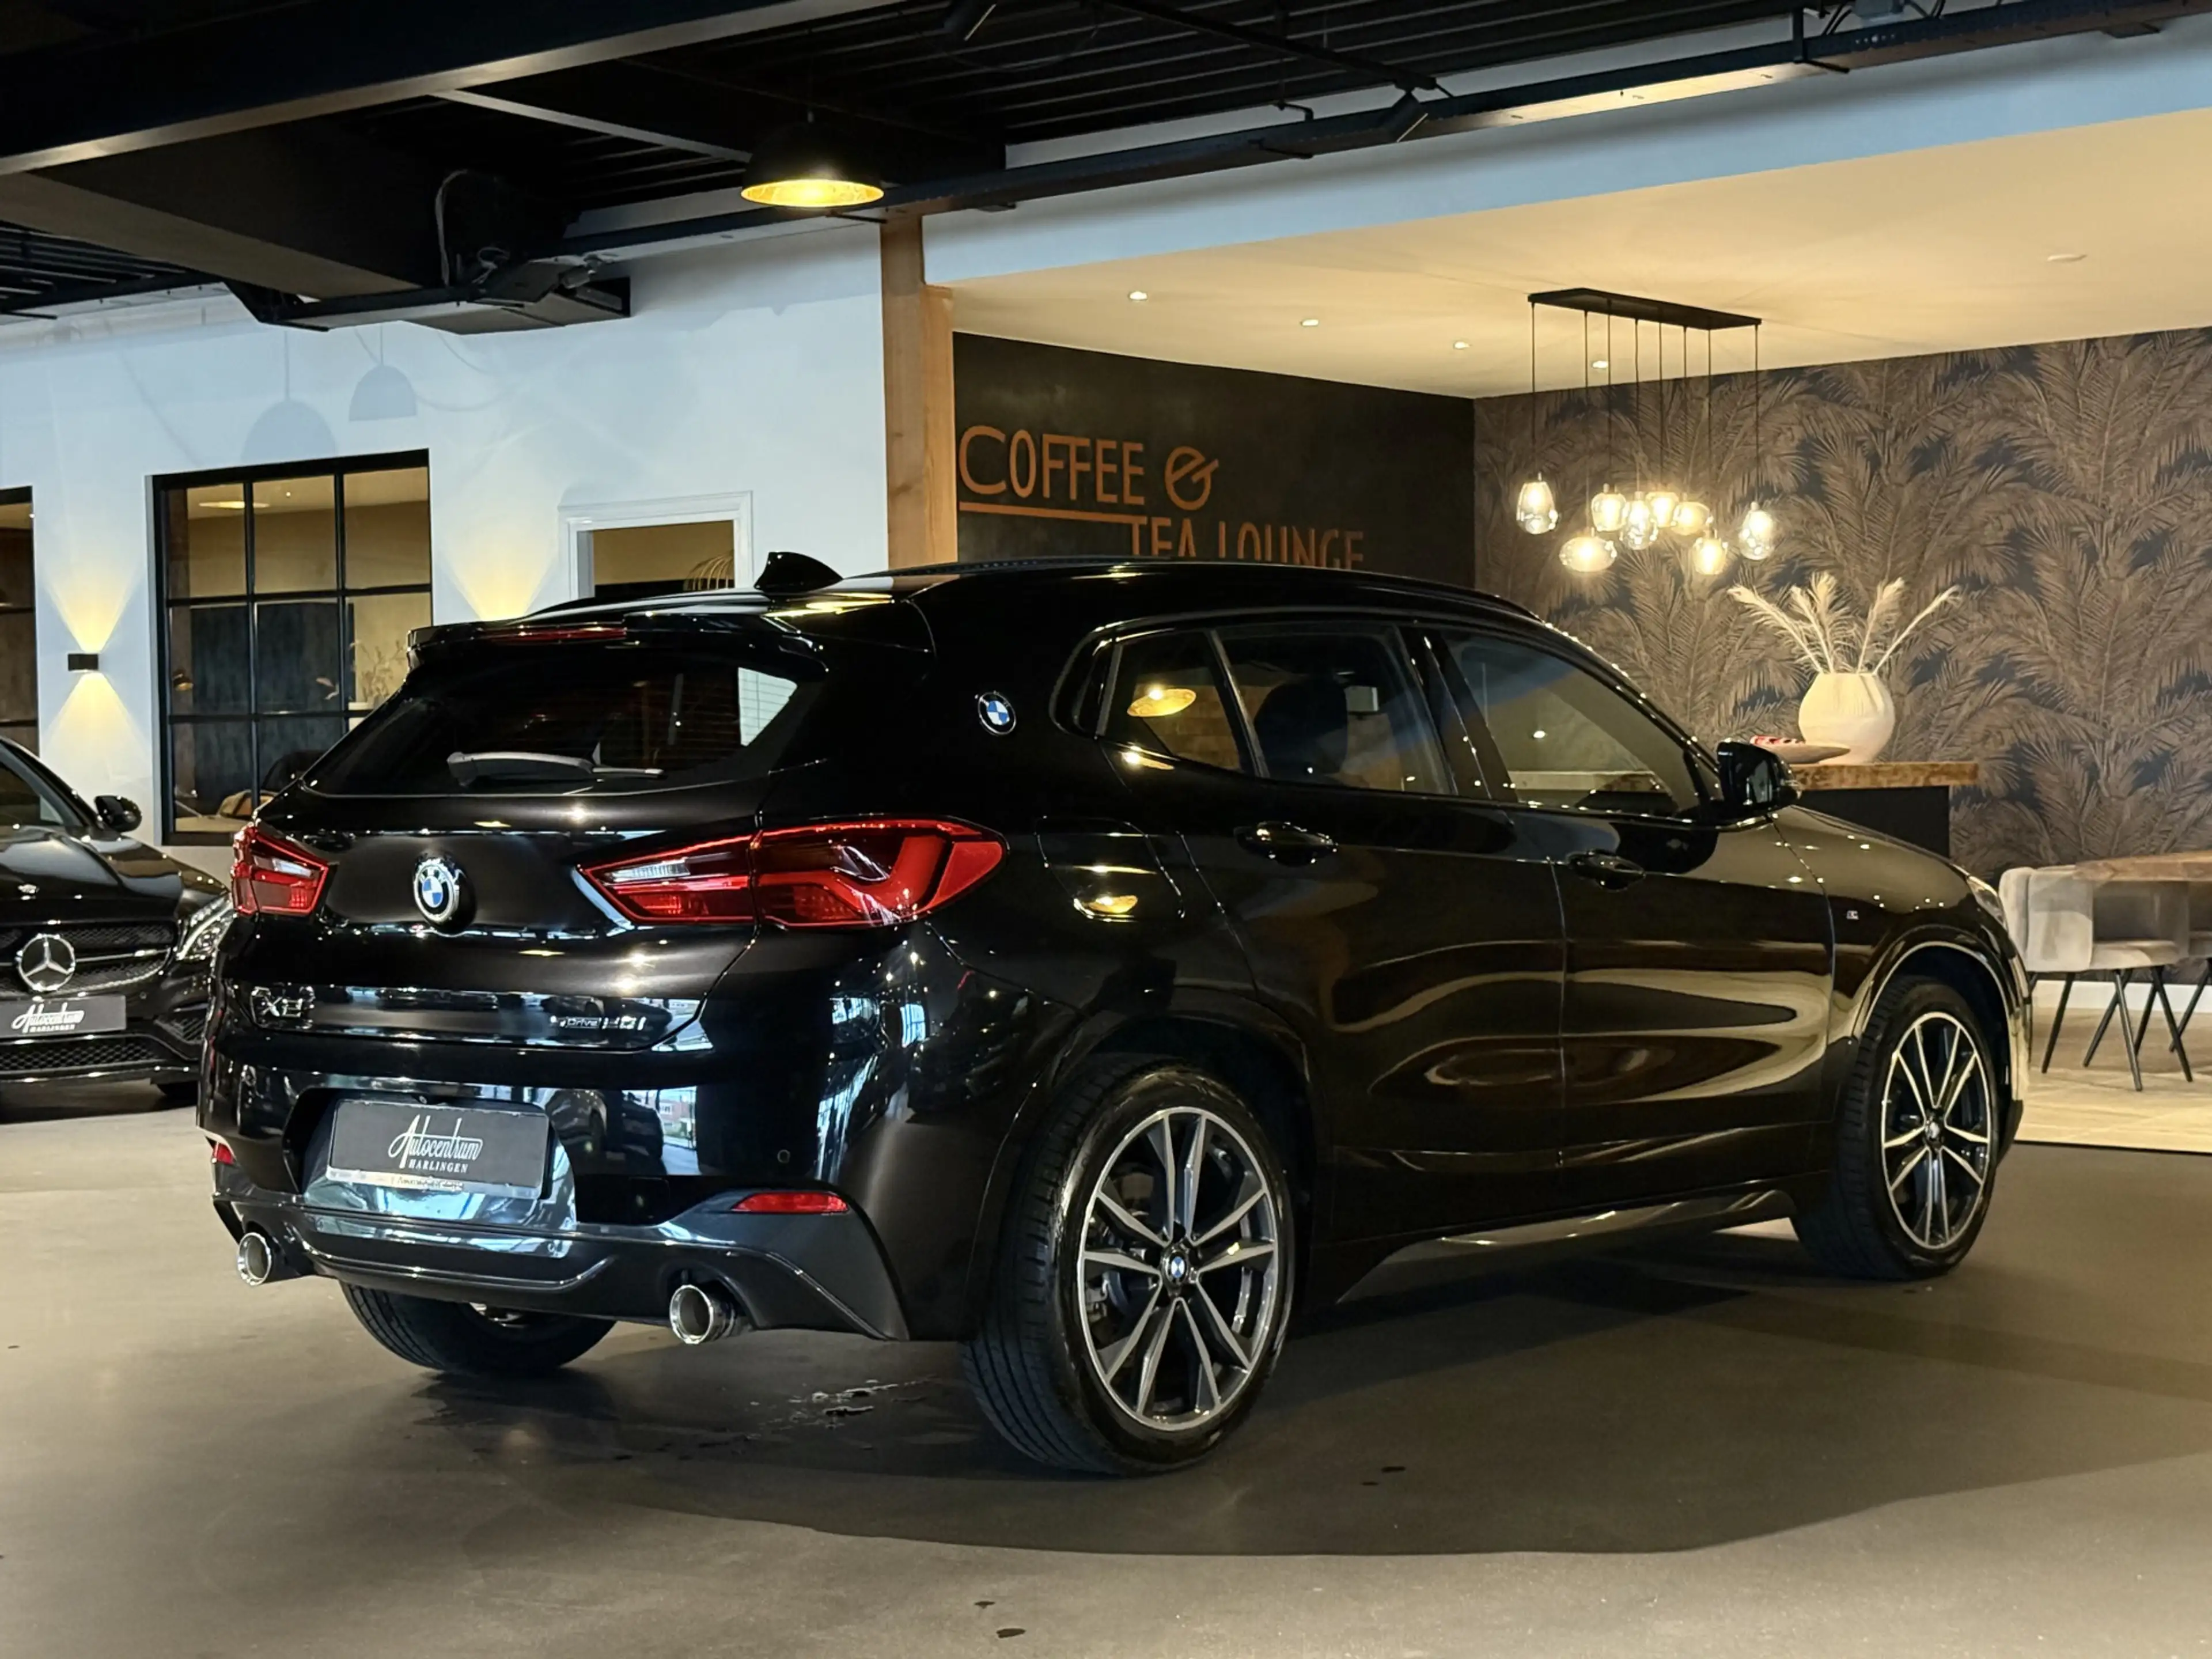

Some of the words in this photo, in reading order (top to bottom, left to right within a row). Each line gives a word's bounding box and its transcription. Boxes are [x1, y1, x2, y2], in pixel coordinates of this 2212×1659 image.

[959, 425, 1145, 505] COFFEE
[1130, 515, 1196, 558] TEA
[388, 1114, 483, 1169] Autocentrum
[408, 1158, 468, 1173] HARLINGEN
